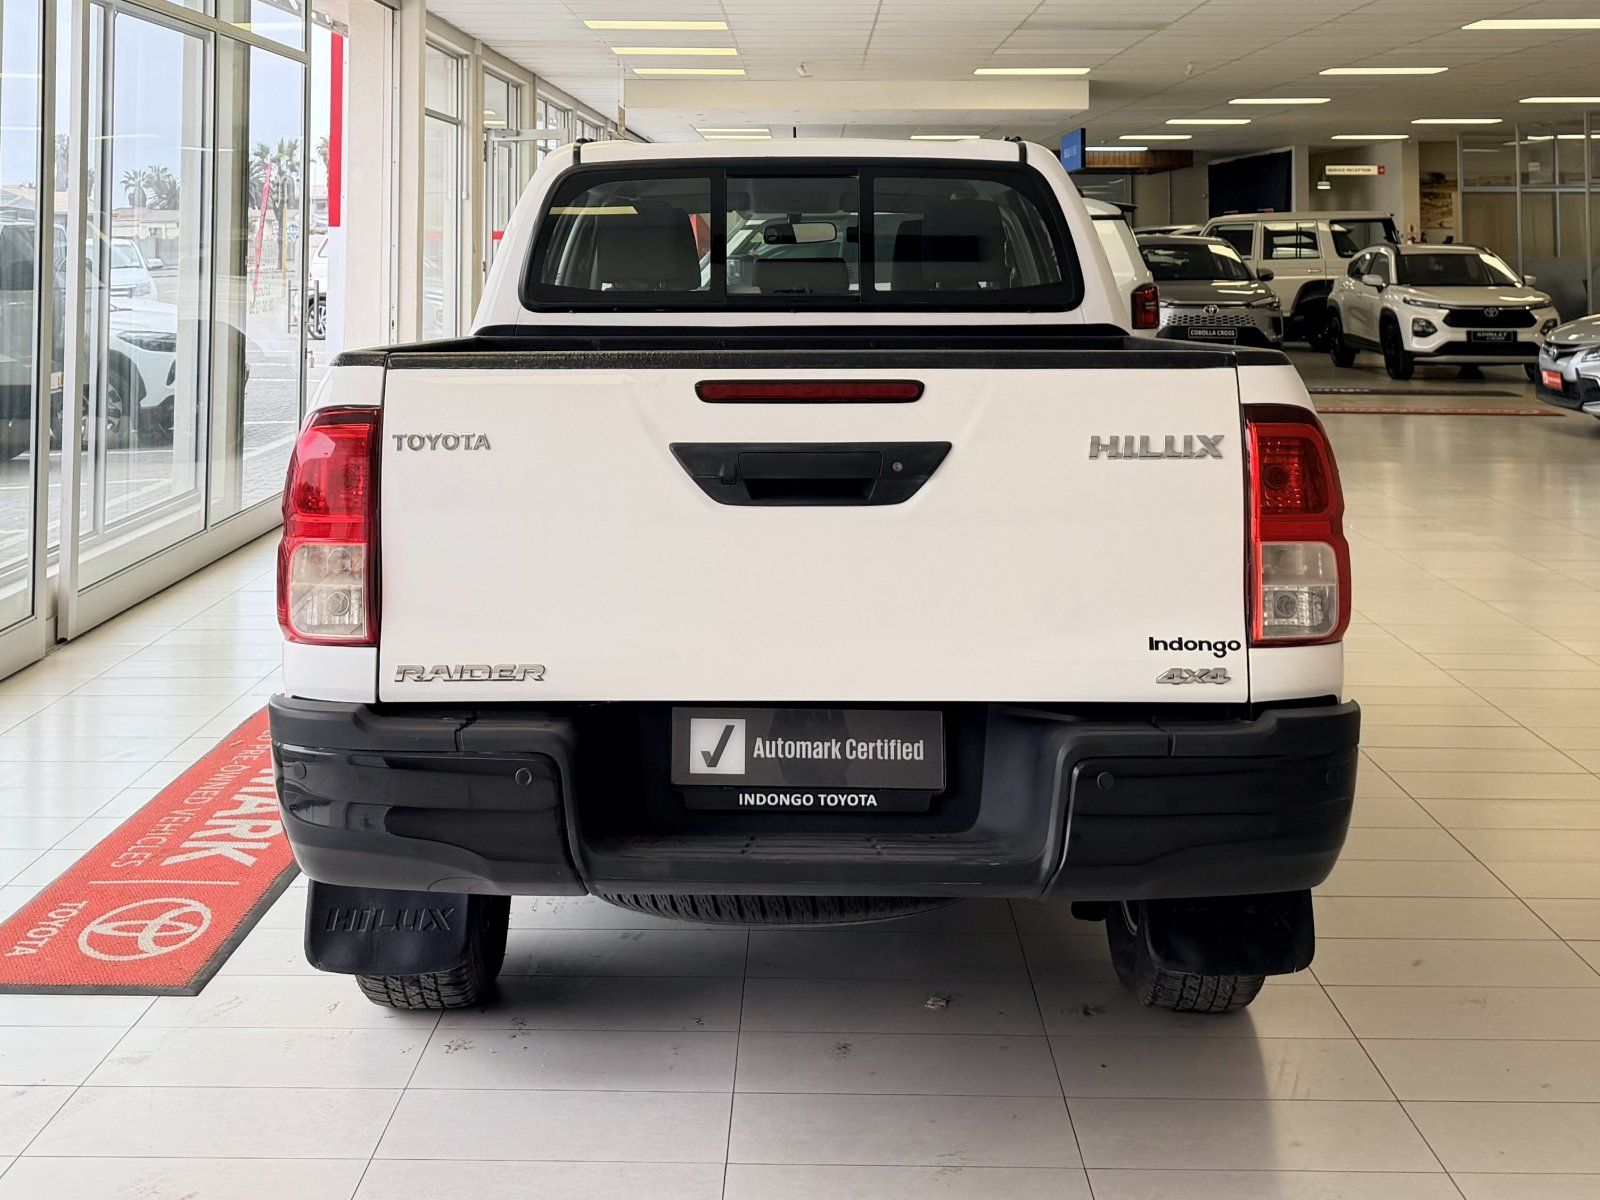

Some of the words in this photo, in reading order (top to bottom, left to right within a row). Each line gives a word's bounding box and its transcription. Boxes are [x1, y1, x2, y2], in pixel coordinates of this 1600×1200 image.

[392, 433, 491, 451] TOYOTA
[1089, 435, 1224, 459] HILUX
[1148, 636, 1241, 658] Indongo
[394, 664, 546, 682] RAIDER
[753, 736, 841, 760] Automark
[845, 737, 924, 761] Certified
[738, 793, 814, 806] INDONGO
[817, 793, 878, 807] TOYOTA
[110, 807, 202, 868] VEHICLES
[3, 899, 90, 957] TOYOTA
[325, 907, 454, 932] HILUX
